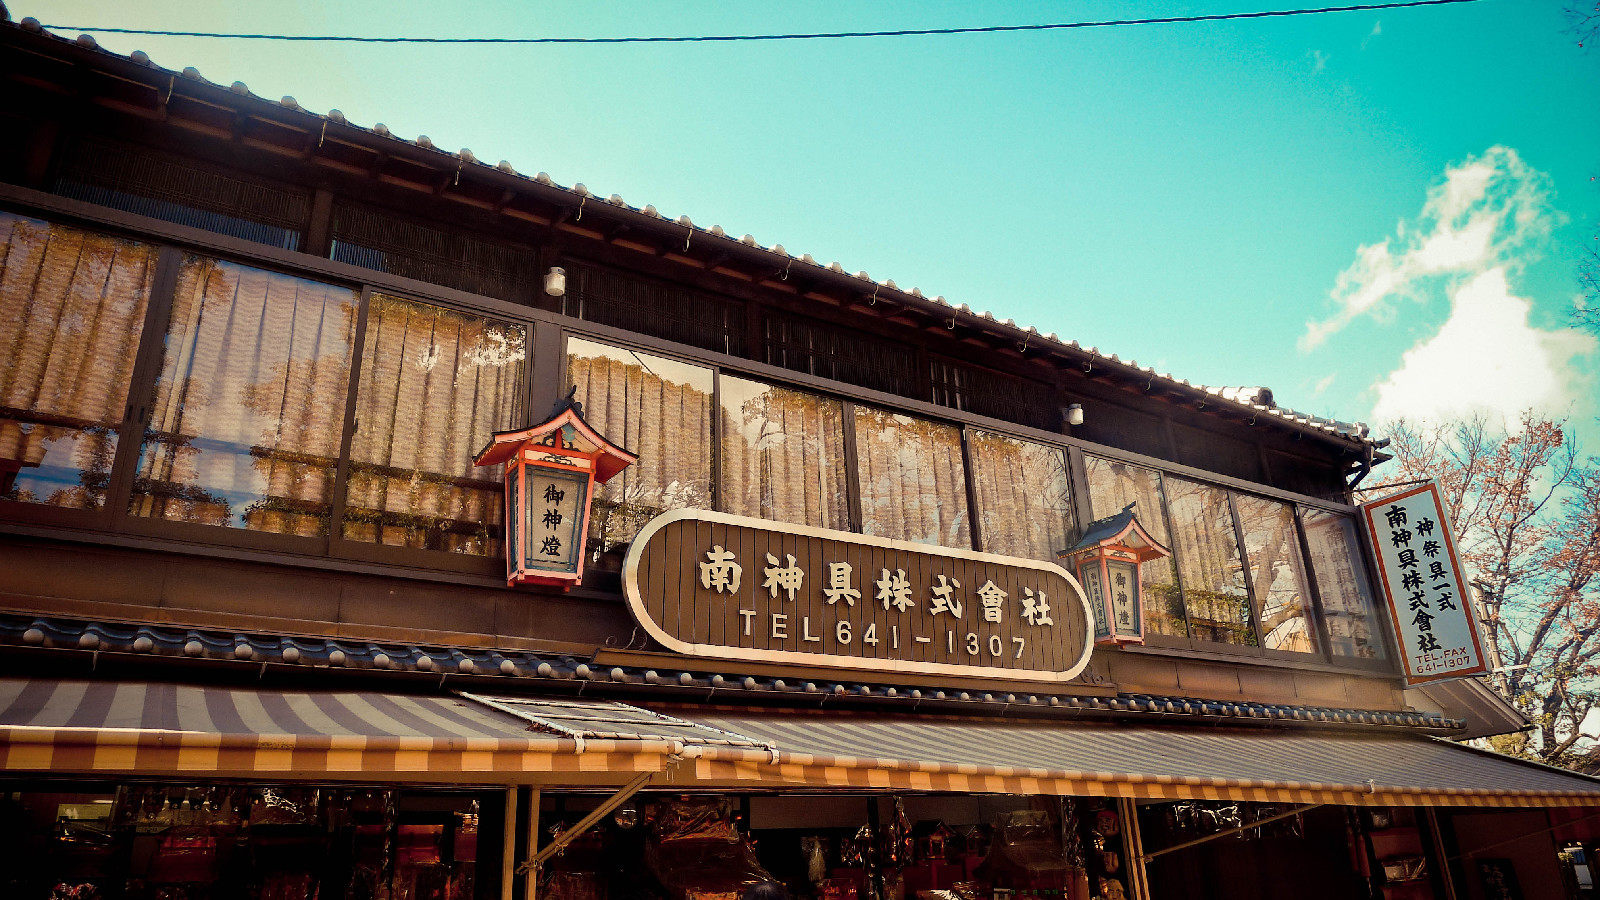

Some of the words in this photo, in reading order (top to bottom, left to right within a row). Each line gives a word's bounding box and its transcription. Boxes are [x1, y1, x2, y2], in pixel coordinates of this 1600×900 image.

[540, 483, 565, 557] 御神燈
[699, 544, 1055, 627] 南神具株式會社
[1384, 504, 1442, 654] 南神具株式會社
[1415, 517, 1457, 612] 神祭具一式
[738, 608, 821, 643] TEL
[836, 620, 1026, 660] 641-1307
[1416, 655, 1471, 674] 641-1307
